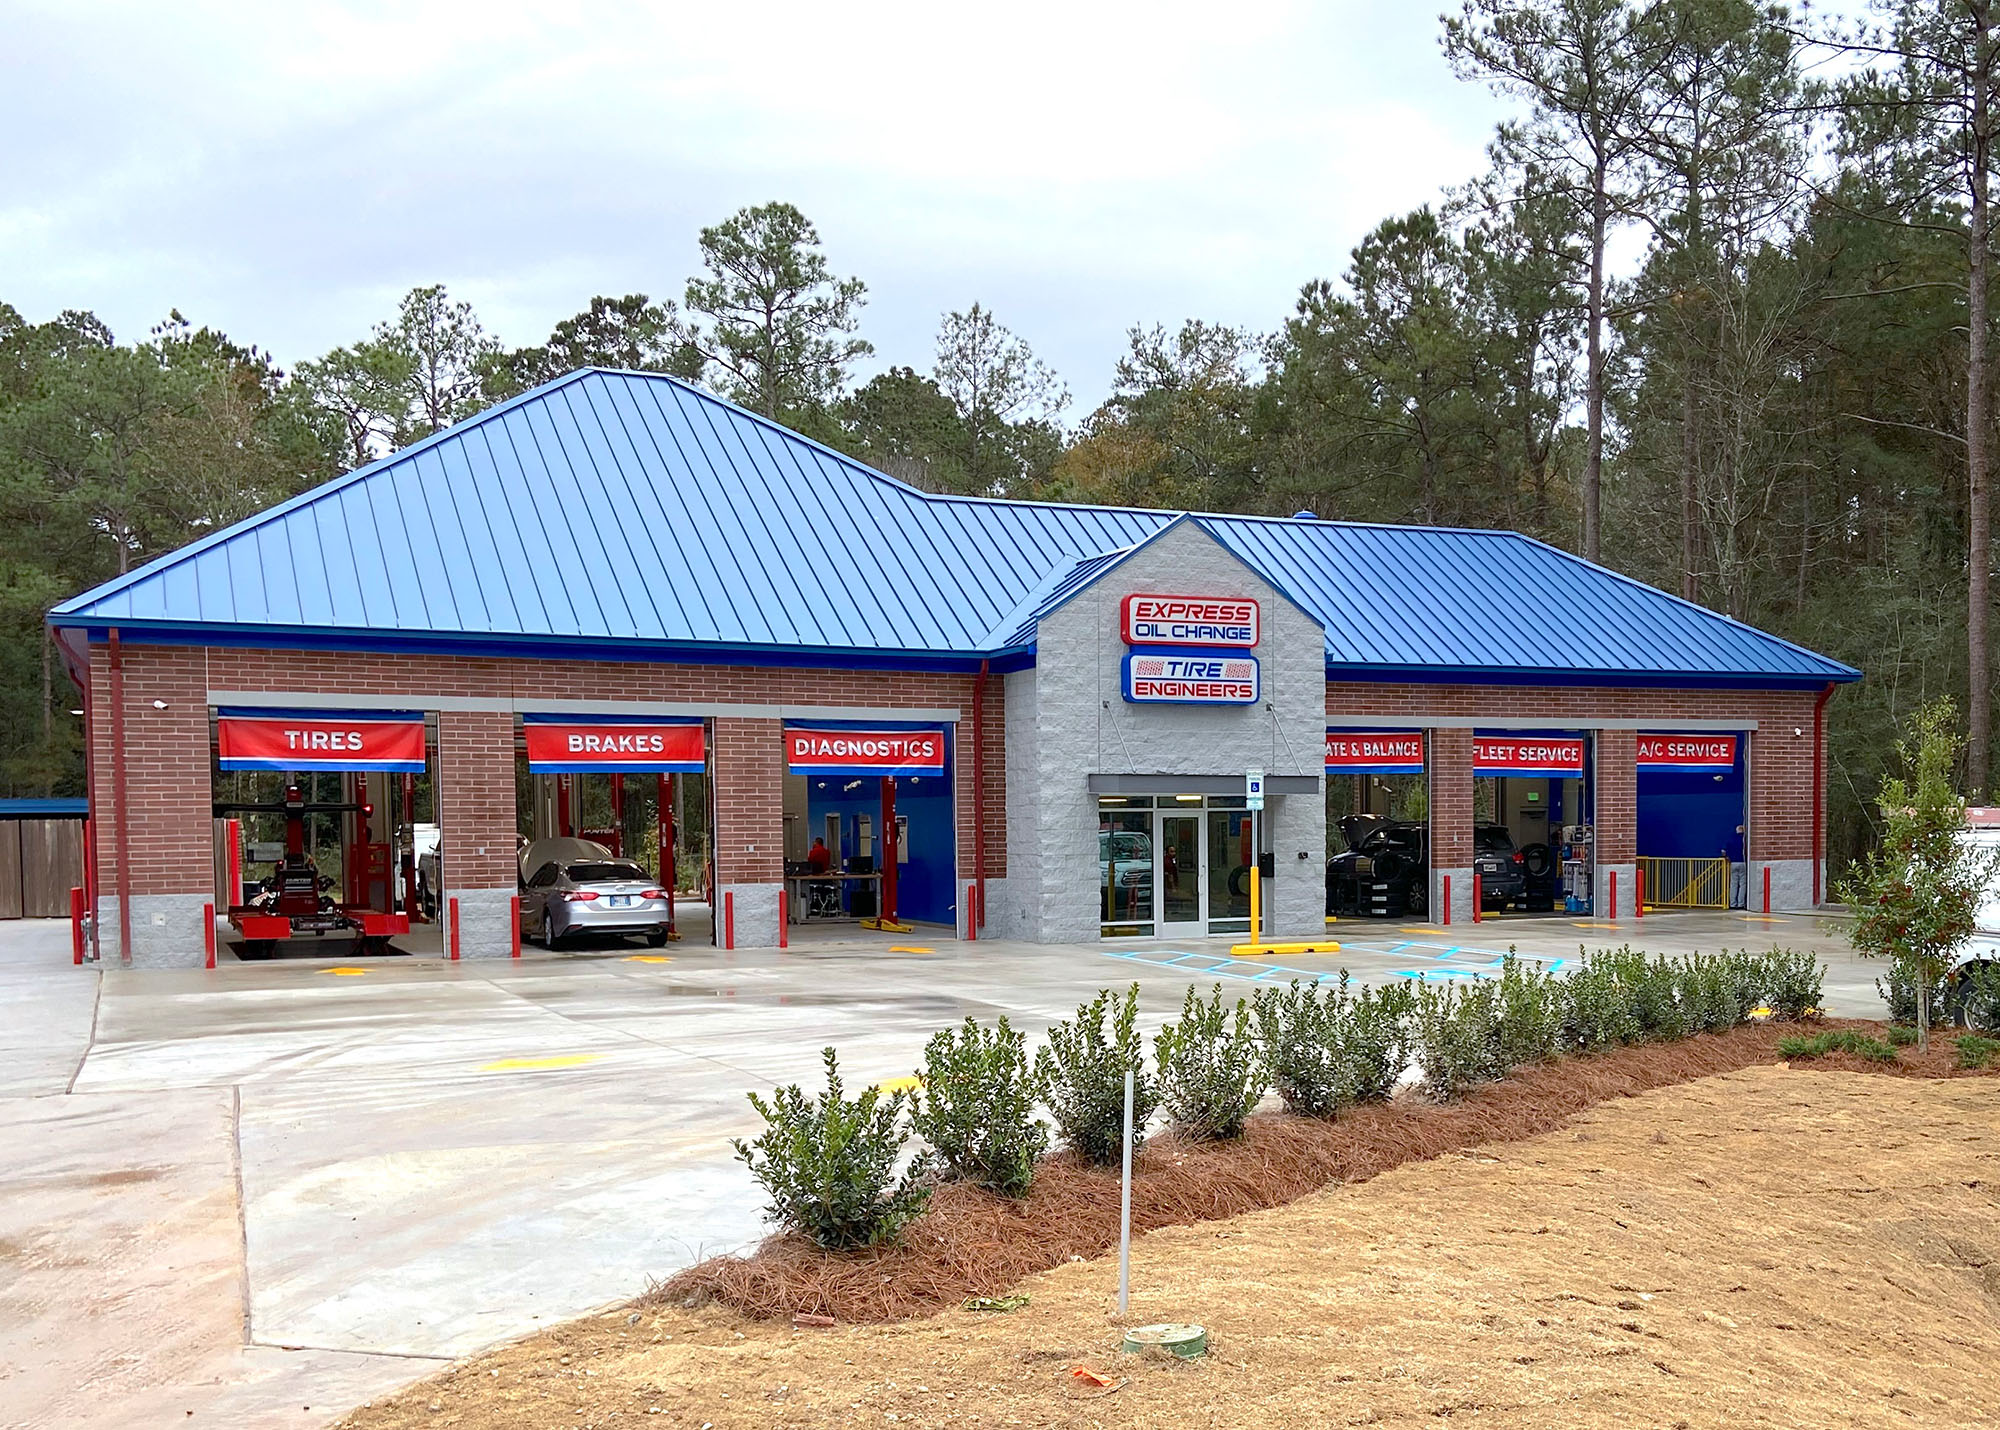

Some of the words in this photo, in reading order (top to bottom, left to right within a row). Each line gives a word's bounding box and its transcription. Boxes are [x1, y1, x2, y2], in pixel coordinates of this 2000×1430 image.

[1135, 602, 1252, 621] EXPRESS
[1135, 623, 1167, 638] OIL
[1171, 625, 1251, 640] CHANGE
[1167, 661, 1223, 678] TIRE
[1135, 682, 1253, 698] ENGINEERS
[284, 730, 363, 751] TIRES
[568, 734, 664, 753] BRAKES
[795, 738, 935, 757] DIAGNOSTICS
[1351, 742, 1360, 757] &
[1363, 741, 1419, 757] BALANCE
[1518, 746, 1579, 762] SERVICE
[1638, 741, 1664, 758] A/C
[1667, 742, 1729, 757] SERVICE
